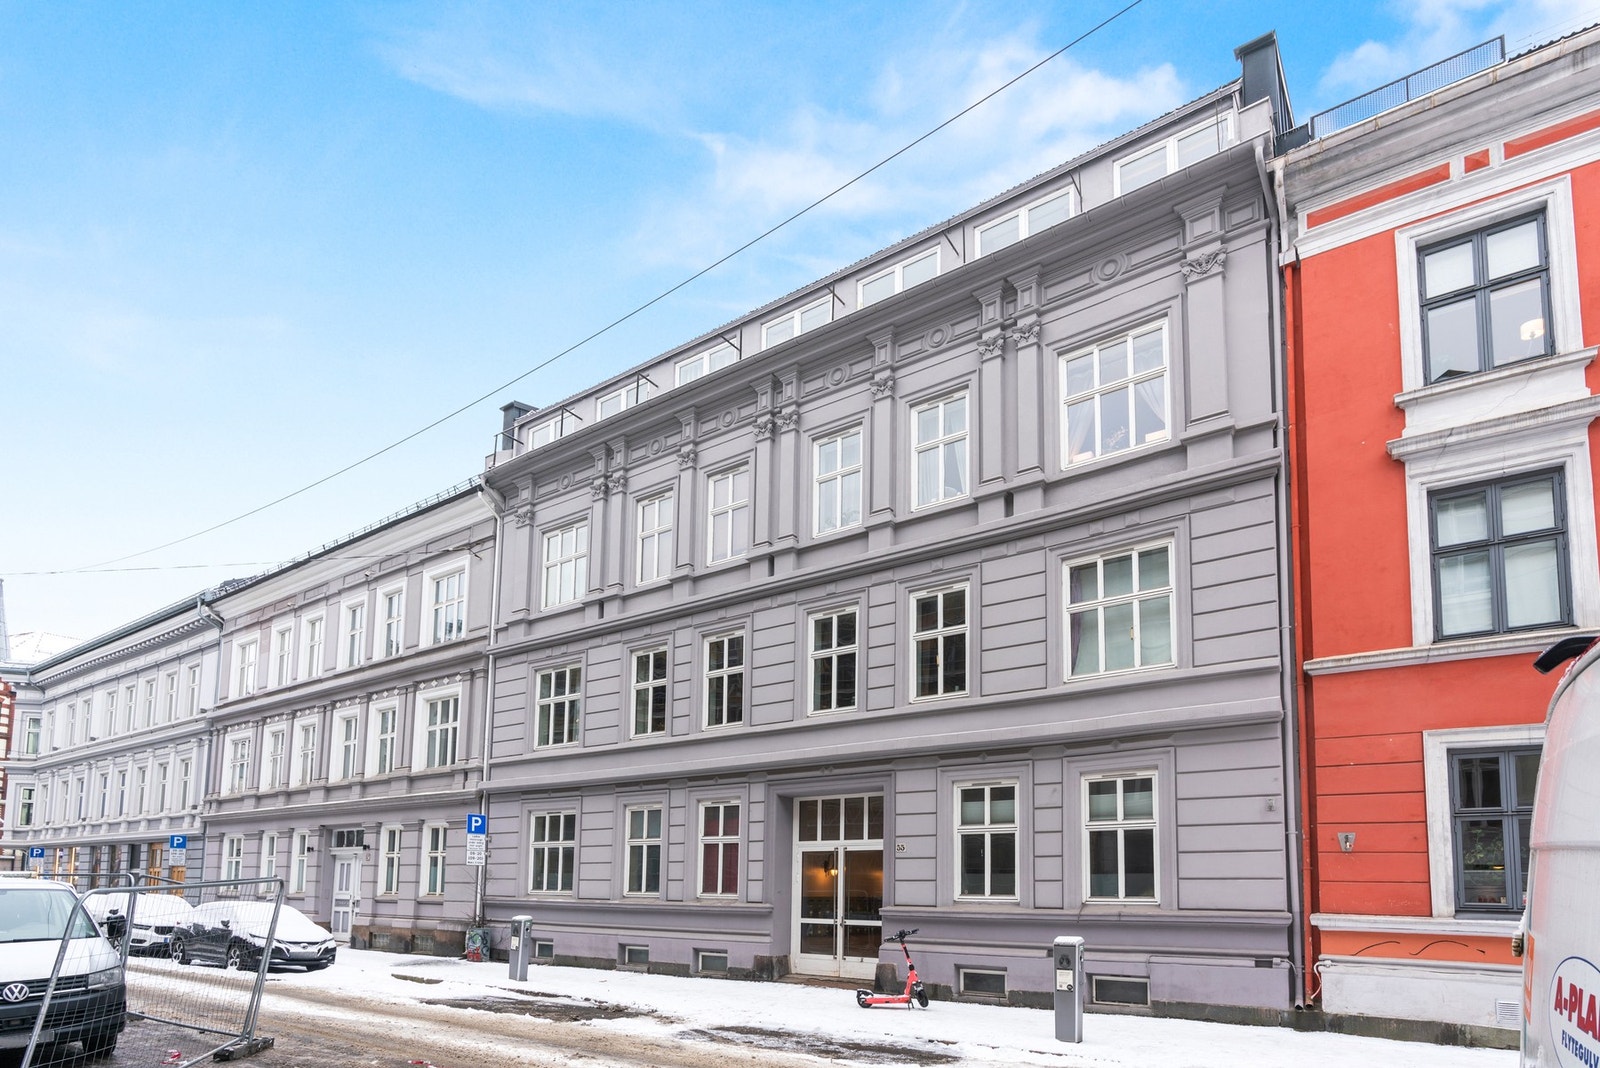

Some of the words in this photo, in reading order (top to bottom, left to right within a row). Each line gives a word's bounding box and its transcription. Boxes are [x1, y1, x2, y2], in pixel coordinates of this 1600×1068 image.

[472, 817, 482, 832] P
[173, 837, 183, 847] P
[33, 849, 41, 857] P
[1554, 976, 1600, 1042] A-PLA
